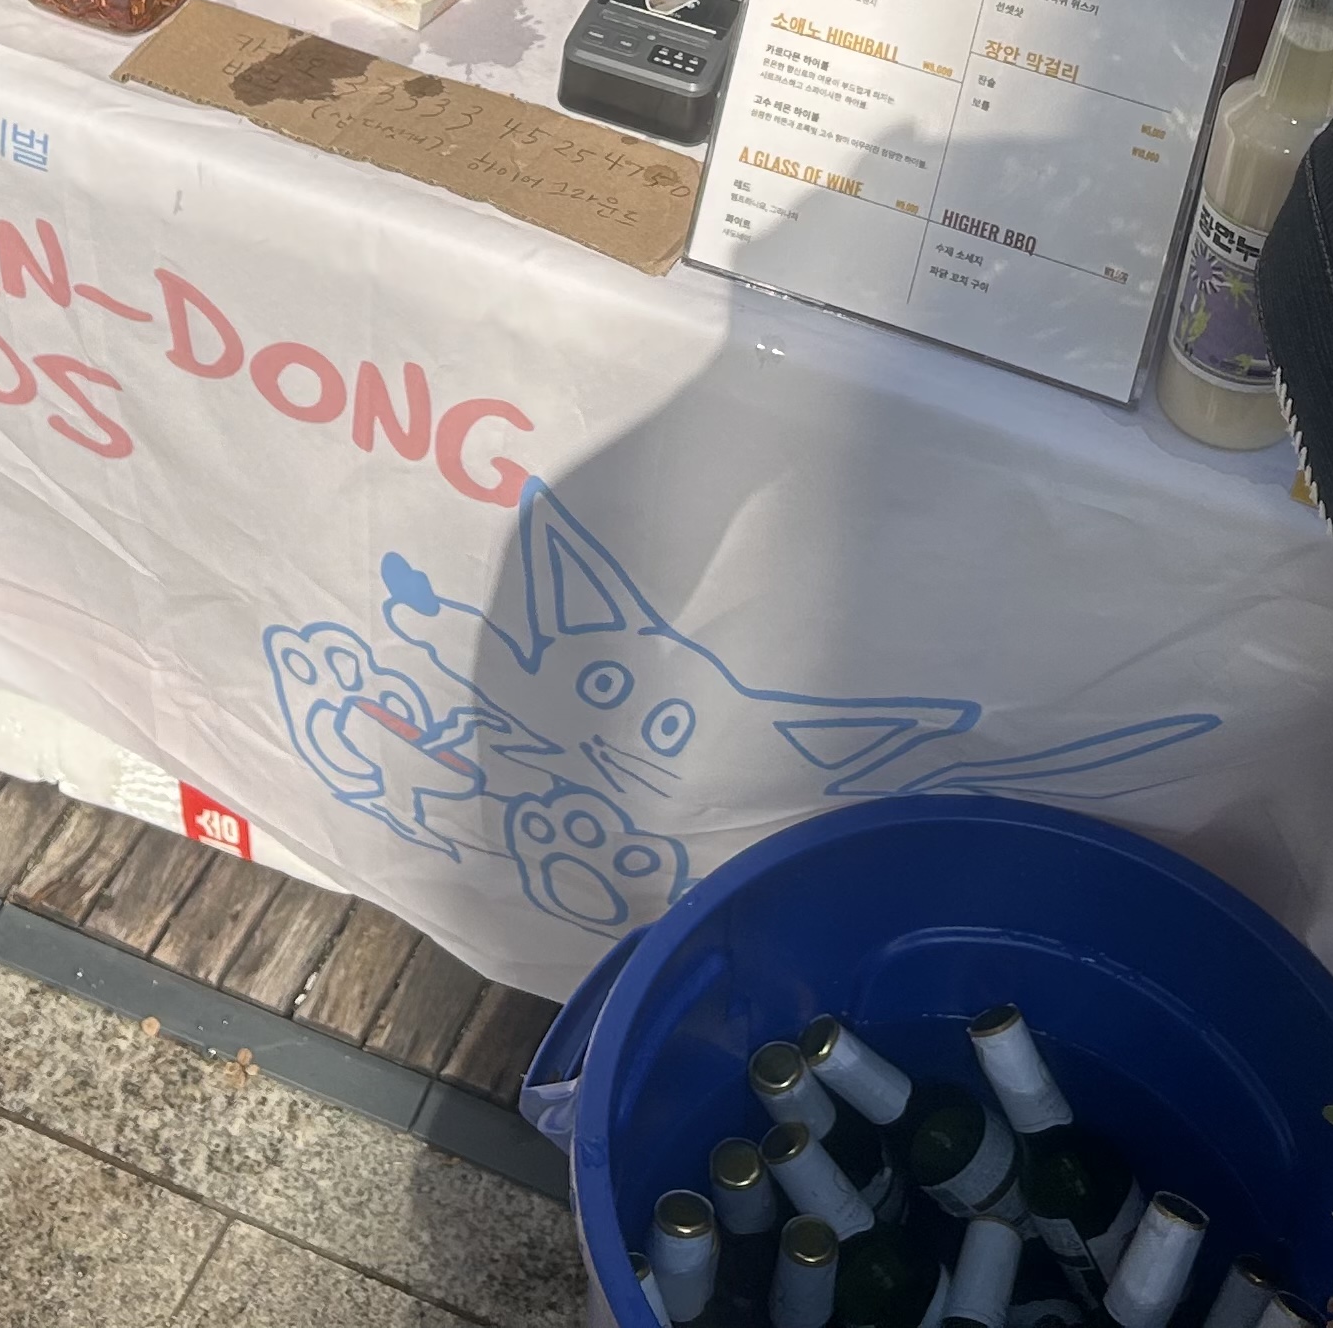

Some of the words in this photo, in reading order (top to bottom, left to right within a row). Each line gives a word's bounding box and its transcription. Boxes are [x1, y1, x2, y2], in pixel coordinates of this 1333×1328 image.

[995, 1, 1023, 17] 선셋샷
[772, 11, 821, 38] 소애노
[825, 27, 899, 62] HIGHBALL
[983, 40, 1019, 64] 장안
[1024, 52, 1079, 82] 막걸리
[978, 75, 995, 88] 잔술
[753, 95, 771, 107] 고수
[773, 101, 790, 113] 레몬
[739, 146, 749, 162] A
[752, 150, 800, 178] GLASS
[803, 166, 822, 184] OF
[825, 173, 863, 196] WINE
[466, 151, 544, 189] 하이어
[547, 182, 638, 227] 그라운드
[733, 179, 751, 191] 레드
[725, 214, 751, 228] 화이트
[941, 209, 1000, 241] HIGHER
[1002, 229, 1036, 256] BBQ
[935, 243, 953, 255] 수제
[955, 250, 982, 265] 소세지
[971, 279, 989, 292] 구이
